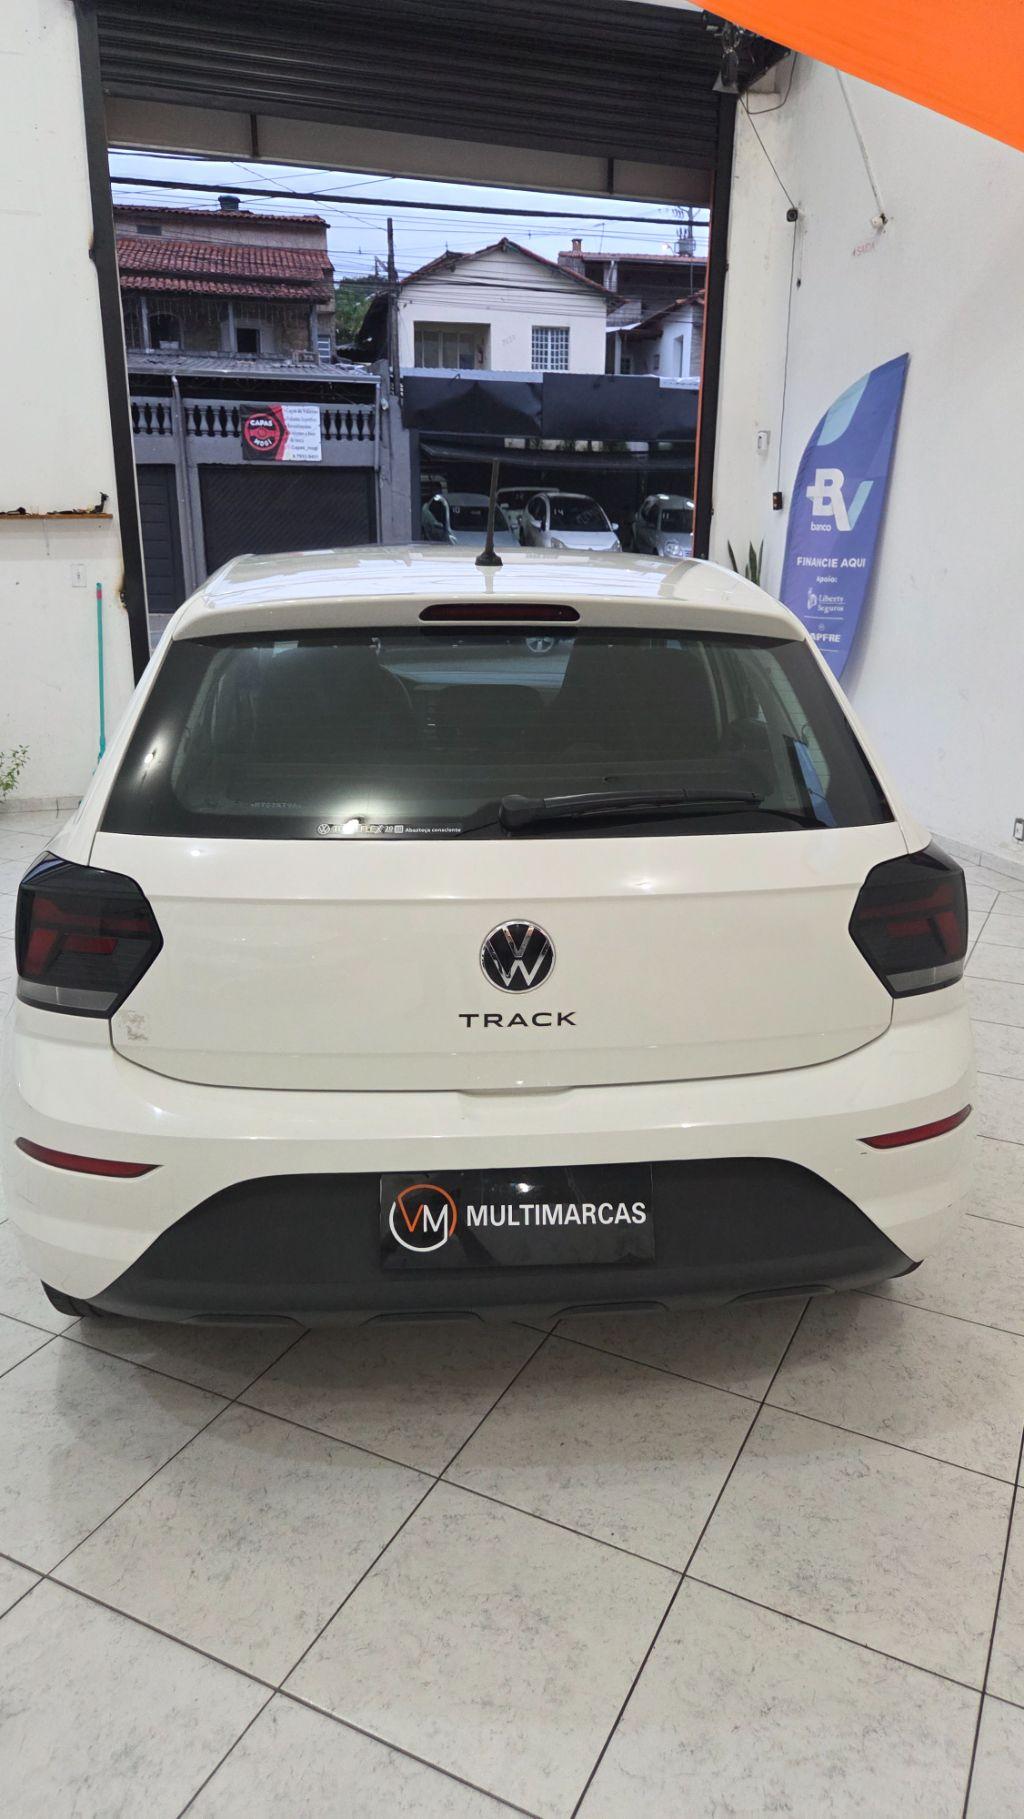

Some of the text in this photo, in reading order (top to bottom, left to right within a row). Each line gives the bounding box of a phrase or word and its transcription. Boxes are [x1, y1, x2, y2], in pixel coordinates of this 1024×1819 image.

[250, 419, 273, 427] CAPAS
[253, 438, 273, 447] MOGI
[811, 521, 832, 531] banco
[797, 557, 866, 568] FINANCIE AQUI
[819, 595, 844, 603] Liberty
[818, 605, 844, 613] Seguros
[810, 633, 841, 642] APFRE
[458, 1011, 577, 1028] TRACK
[466, 1202, 647, 1227] MULTIMARCAS
